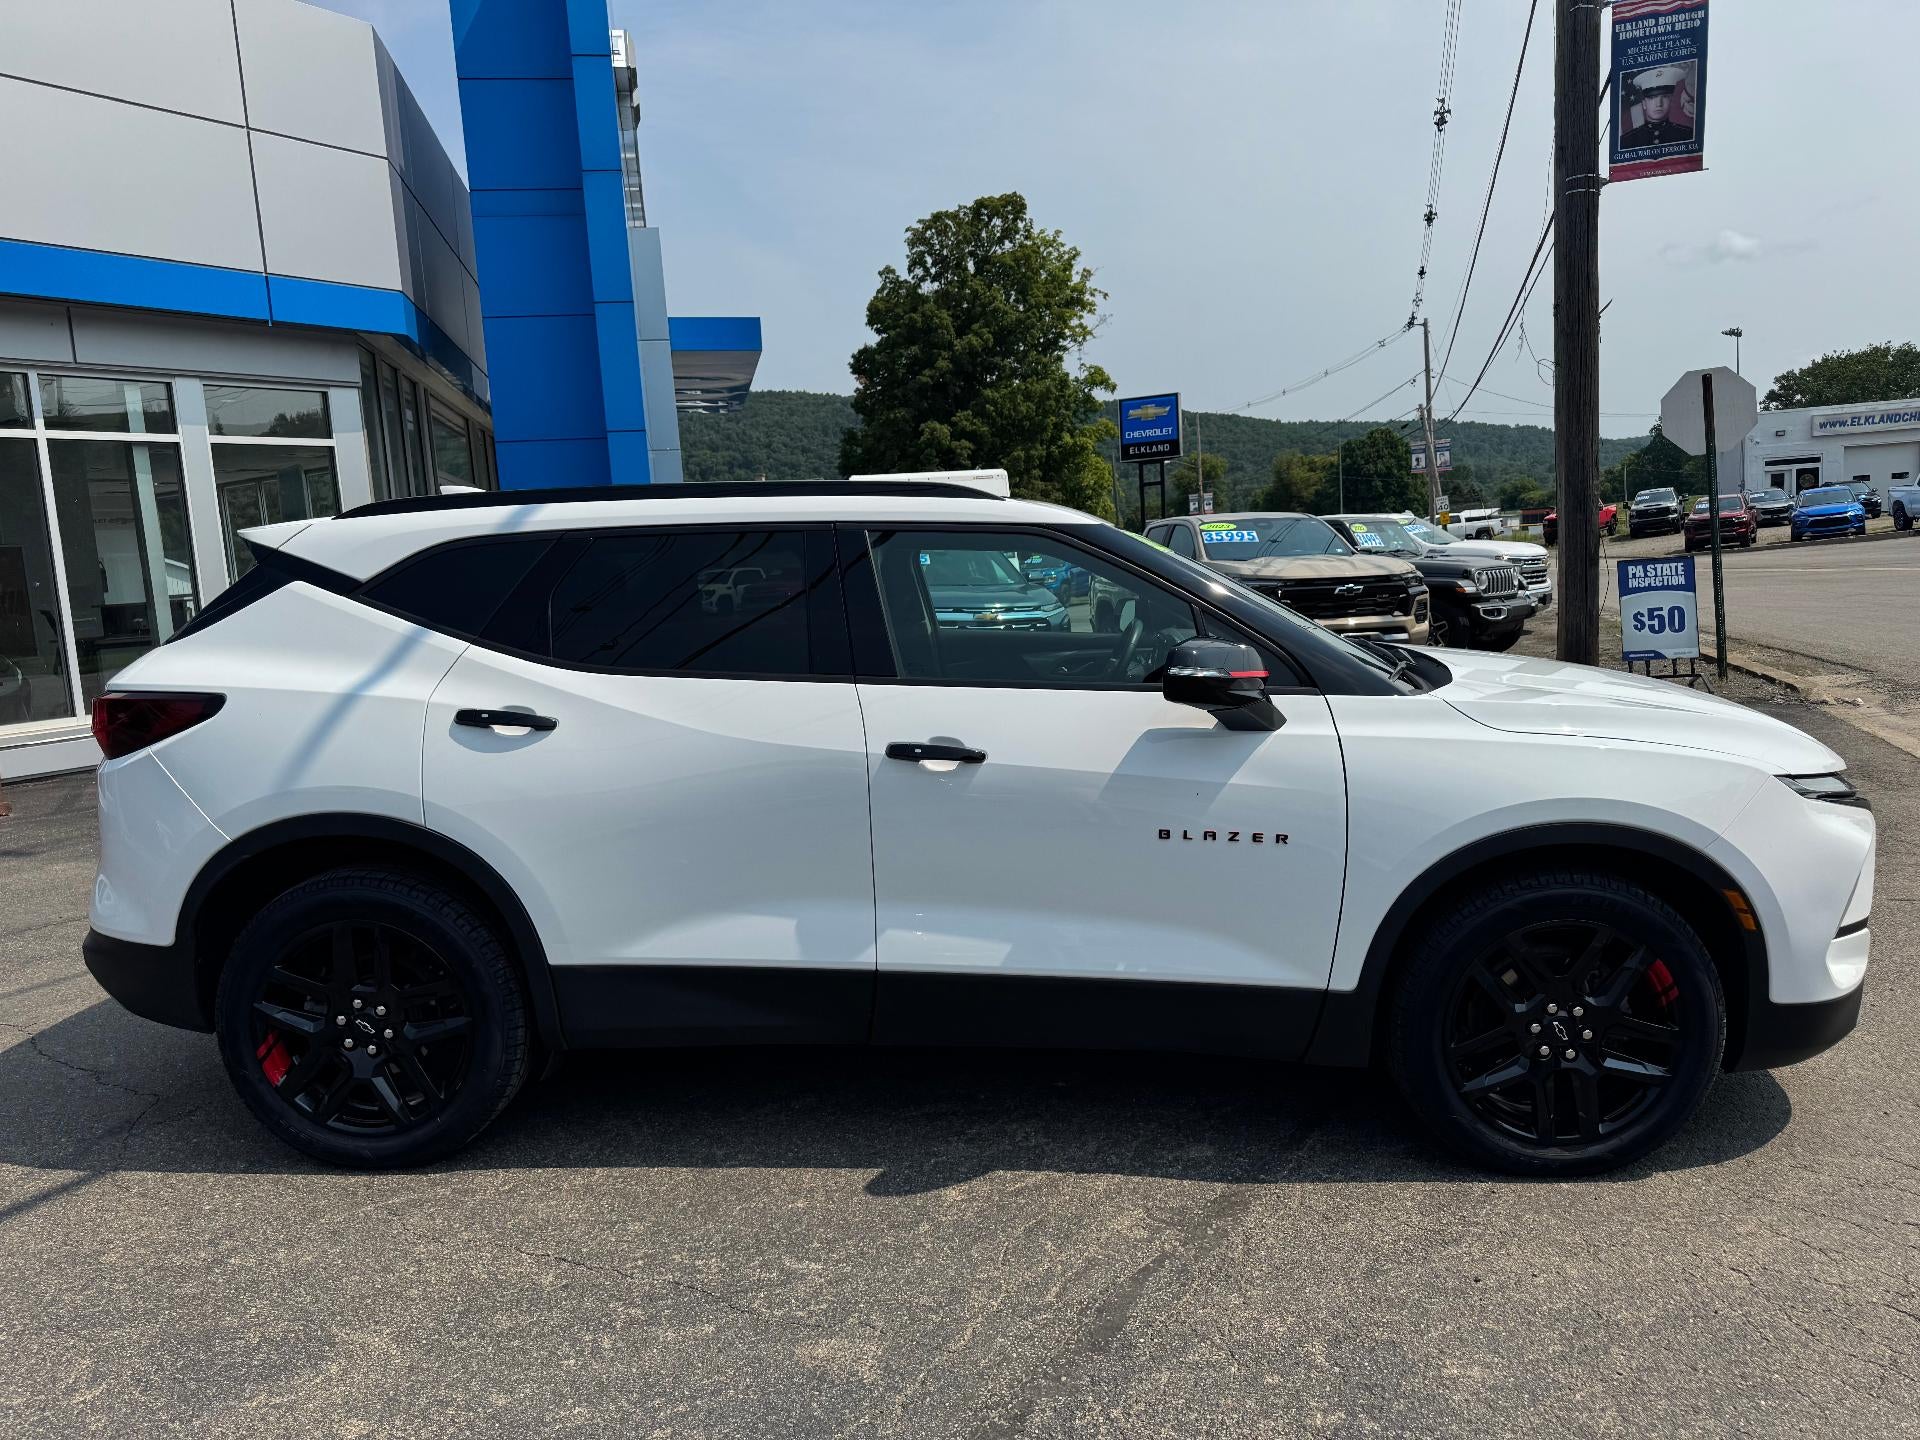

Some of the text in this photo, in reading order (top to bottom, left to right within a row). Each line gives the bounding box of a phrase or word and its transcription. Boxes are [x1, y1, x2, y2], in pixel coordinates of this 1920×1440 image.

[1615, 10, 1705, 32] ELKLAND BOROUGH
[1619, 19, 1701, 40] HOMETOWN HERO
[1627, 38, 1692, 55] MICHAEL PLANK
[1621, 46, 1697, 66] U.S. MARINE CORPS
[1613, 151, 1637, 160] GLOBAL
[1638, 149, 1651, 157] WAR
[1125, 427, 1173, 439] CHEVROLET
[1129, 443, 1170, 455] ELKLAND
[1204, 531, 1256, 542] 35995
[1627, 563, 1685, 578] PA STATE
[1628, 575, 1686, 588] INSPECTION
[1633, 606, 1685, 634] $50
[1158, 829, 1289, 844] BLAZER
